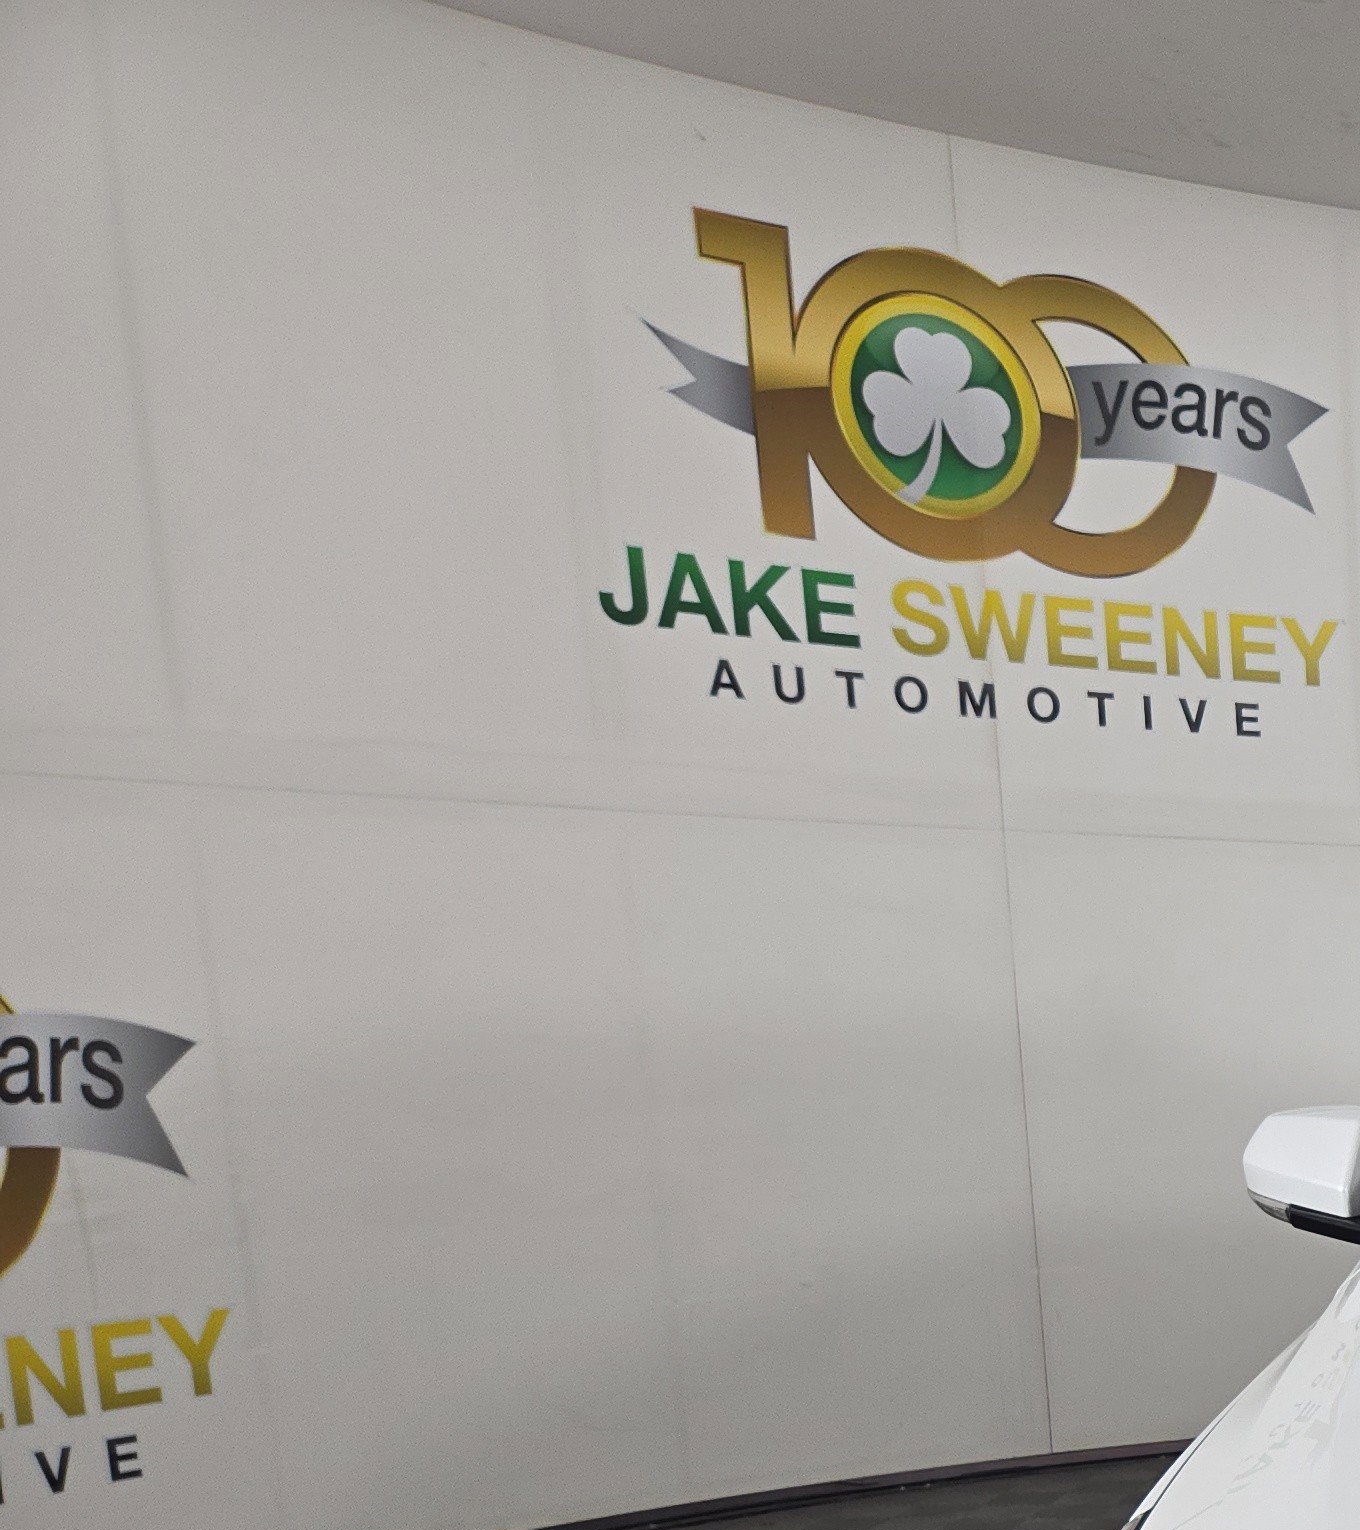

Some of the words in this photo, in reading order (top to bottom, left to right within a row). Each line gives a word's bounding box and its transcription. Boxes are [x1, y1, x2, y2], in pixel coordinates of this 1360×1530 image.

[693, 206, 1217, 578] 100
[1092, 377, 1272, 451] years
[599, 545, 862, 649] JAKE
[891, 579, 1339, 688] SWEENEY
[709, 658, 1262, 737] AUTOMOTIVE
[0, 1035, 124, 1110] ars
[0, 1307, 231, 1431] NEY
[0, 1434, 143, 1505] VE
